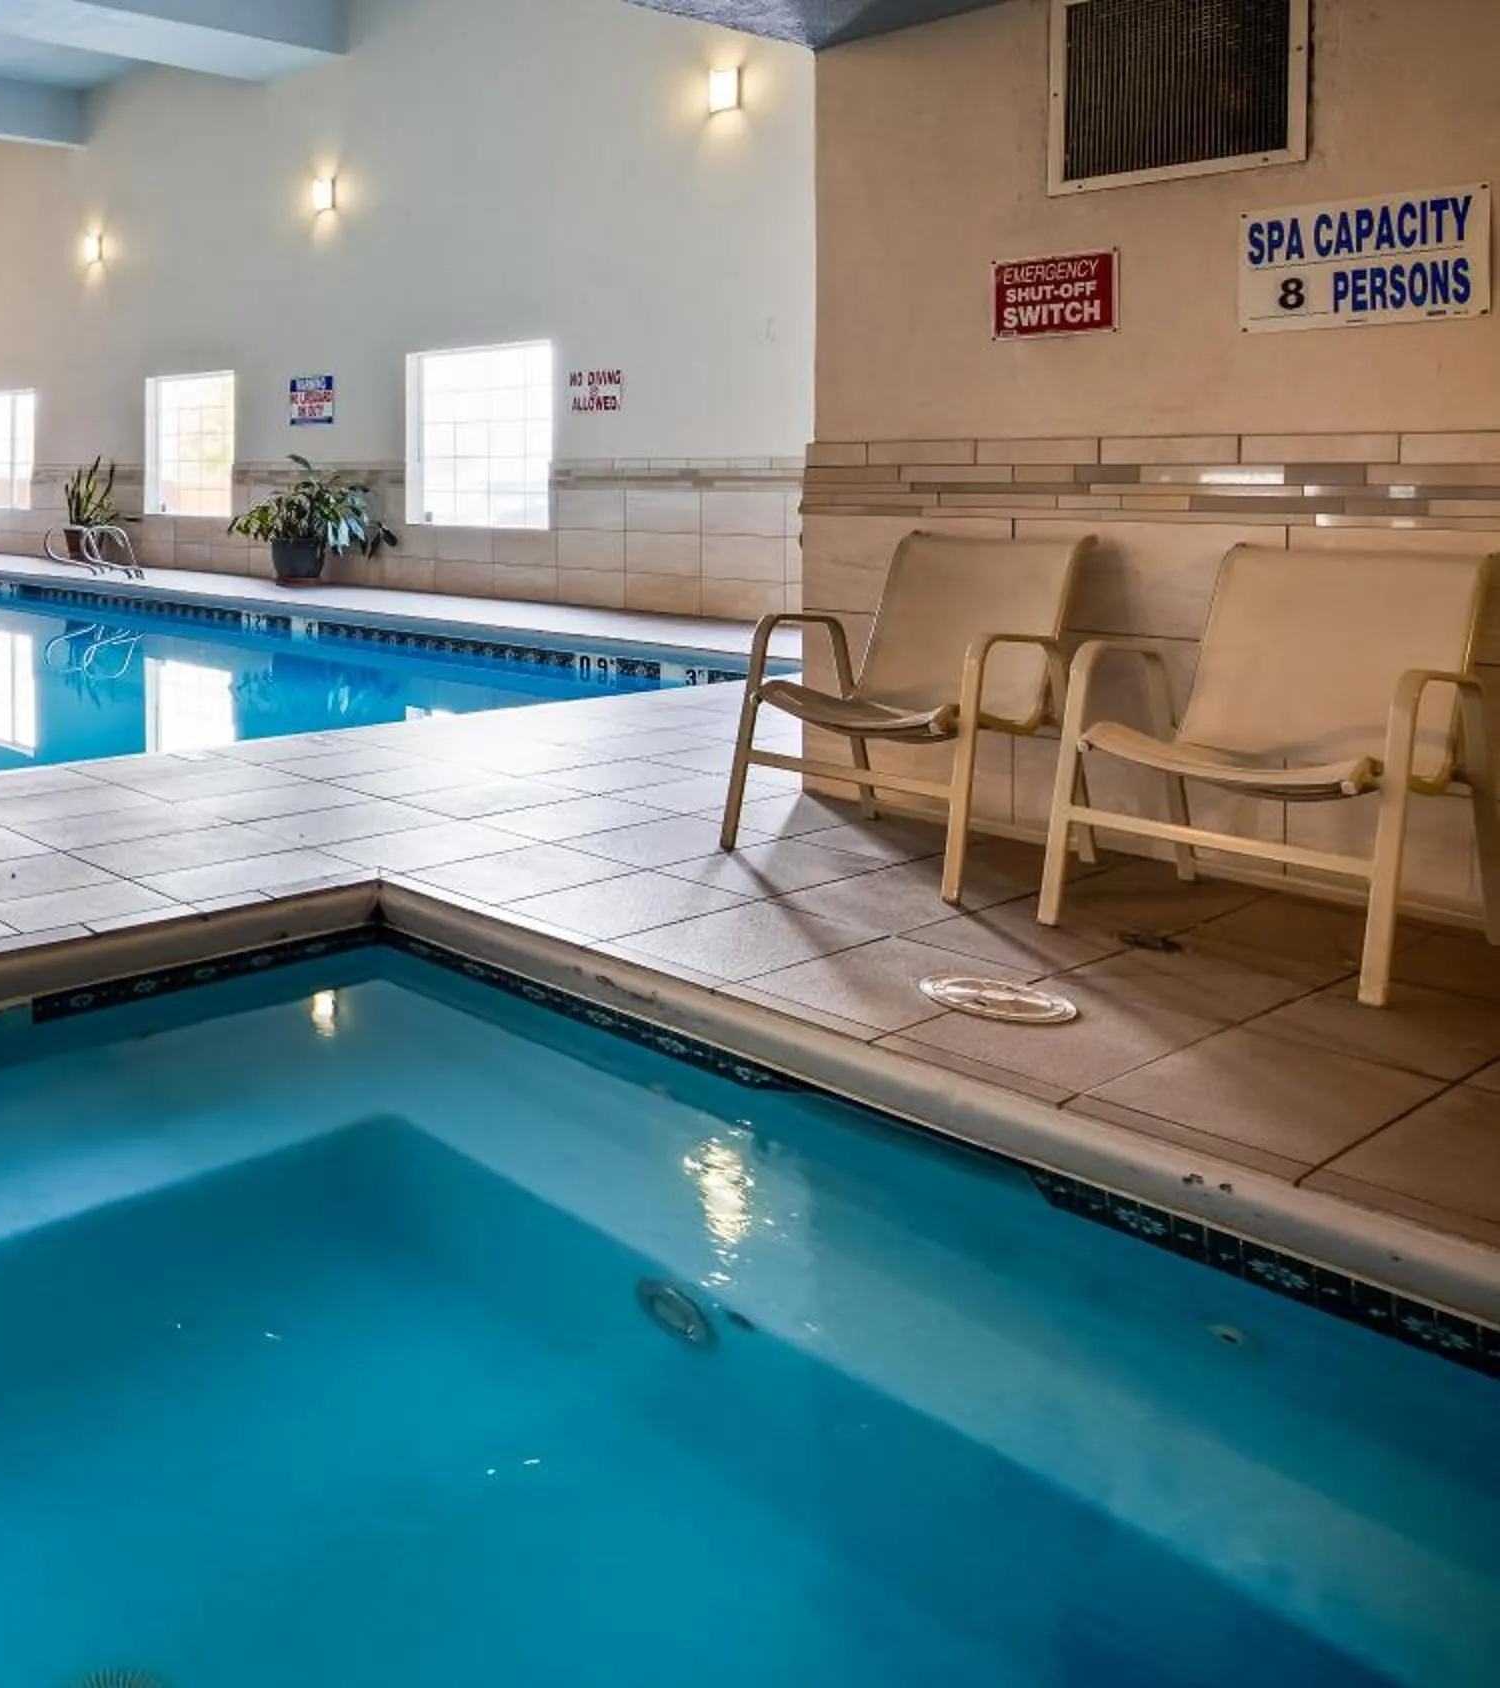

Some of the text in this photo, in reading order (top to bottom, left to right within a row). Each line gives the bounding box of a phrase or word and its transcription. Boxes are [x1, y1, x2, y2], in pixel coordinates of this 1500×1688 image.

[1248, 195, 1472, 265] SPA CAPACITY
[1003, 259, 1099, 285] EMERGENCY
[1278, 257, 1471, 313] 8 PERSONS
[1006, 280, 1097, 303] SHUT-OFF
[1003, 300, 1101, 329] SWITCH
